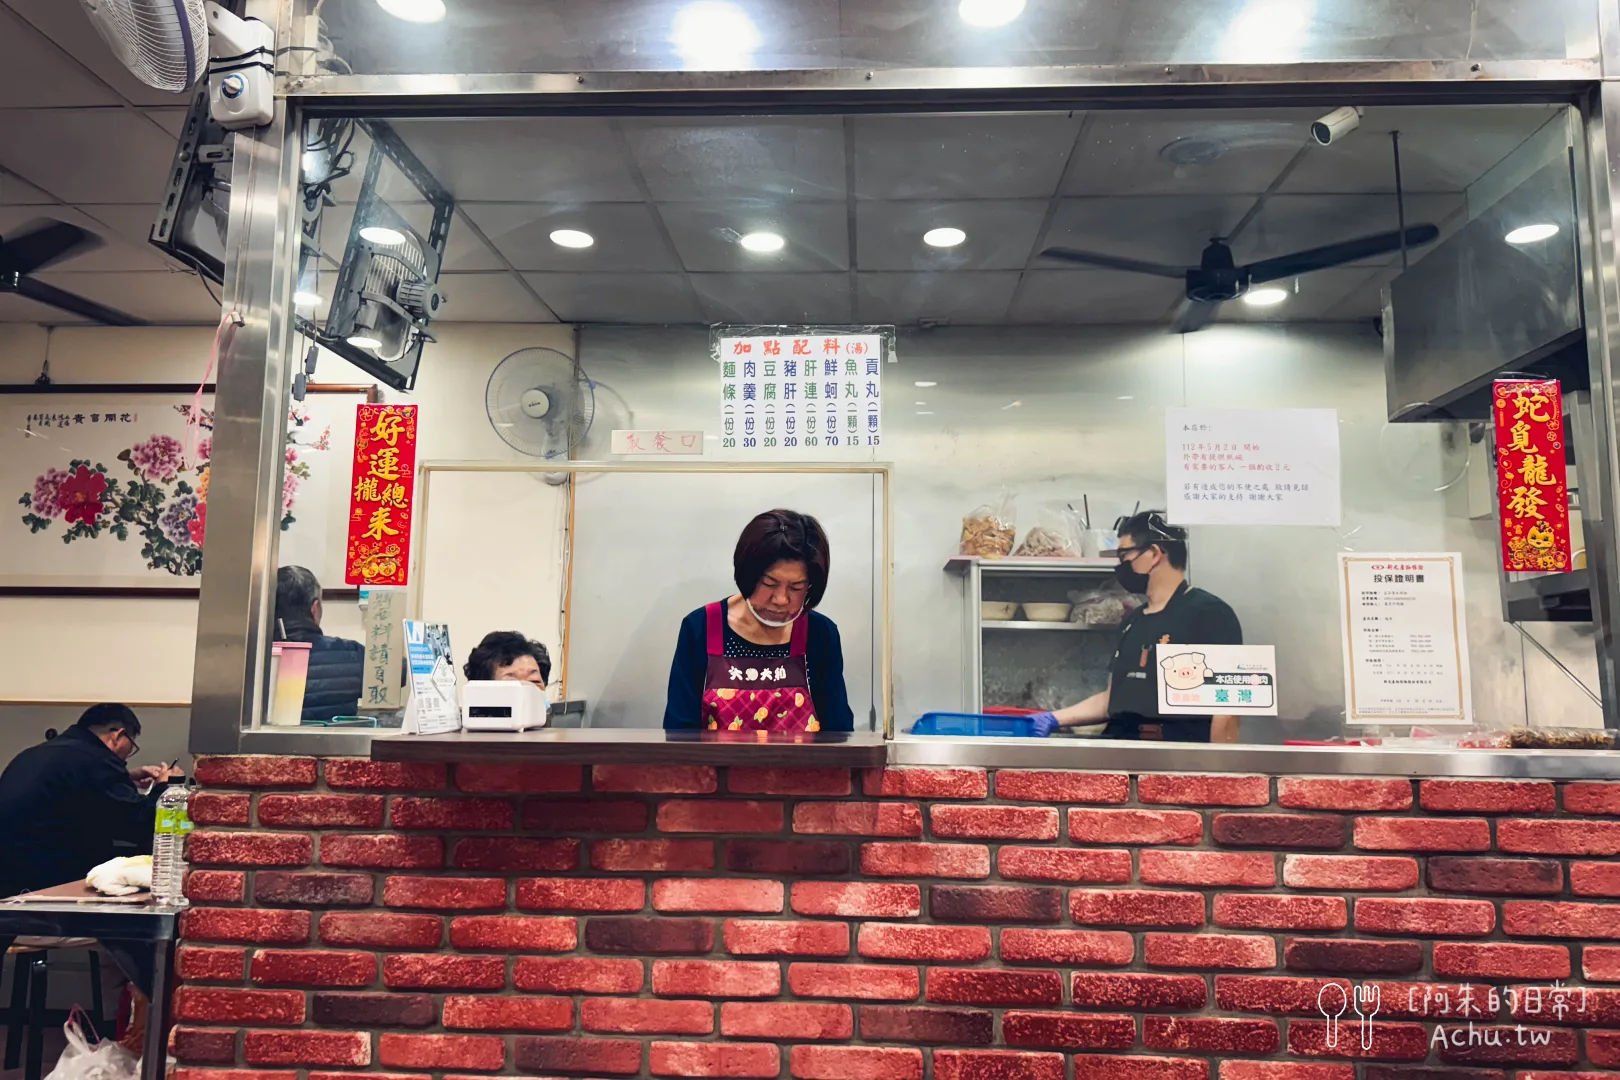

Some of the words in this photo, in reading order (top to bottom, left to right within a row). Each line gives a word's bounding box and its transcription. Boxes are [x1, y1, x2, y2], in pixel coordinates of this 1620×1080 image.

[723, 437, 736, 447] 20
[743, 437, 756, 447] 30
[764, 437, 776, 447] 20
[784, 437, 797, 447] 20
[805, 436, 818, 446] 60
[825, 436, 838, 446] 70
[847, 436, 859, 445] 15
[867, 436, 879, 445] 15
[1507, 391, 1557, 520] 蛇覓龍發
[1373, 574, 1425, 583] 投保證明書
